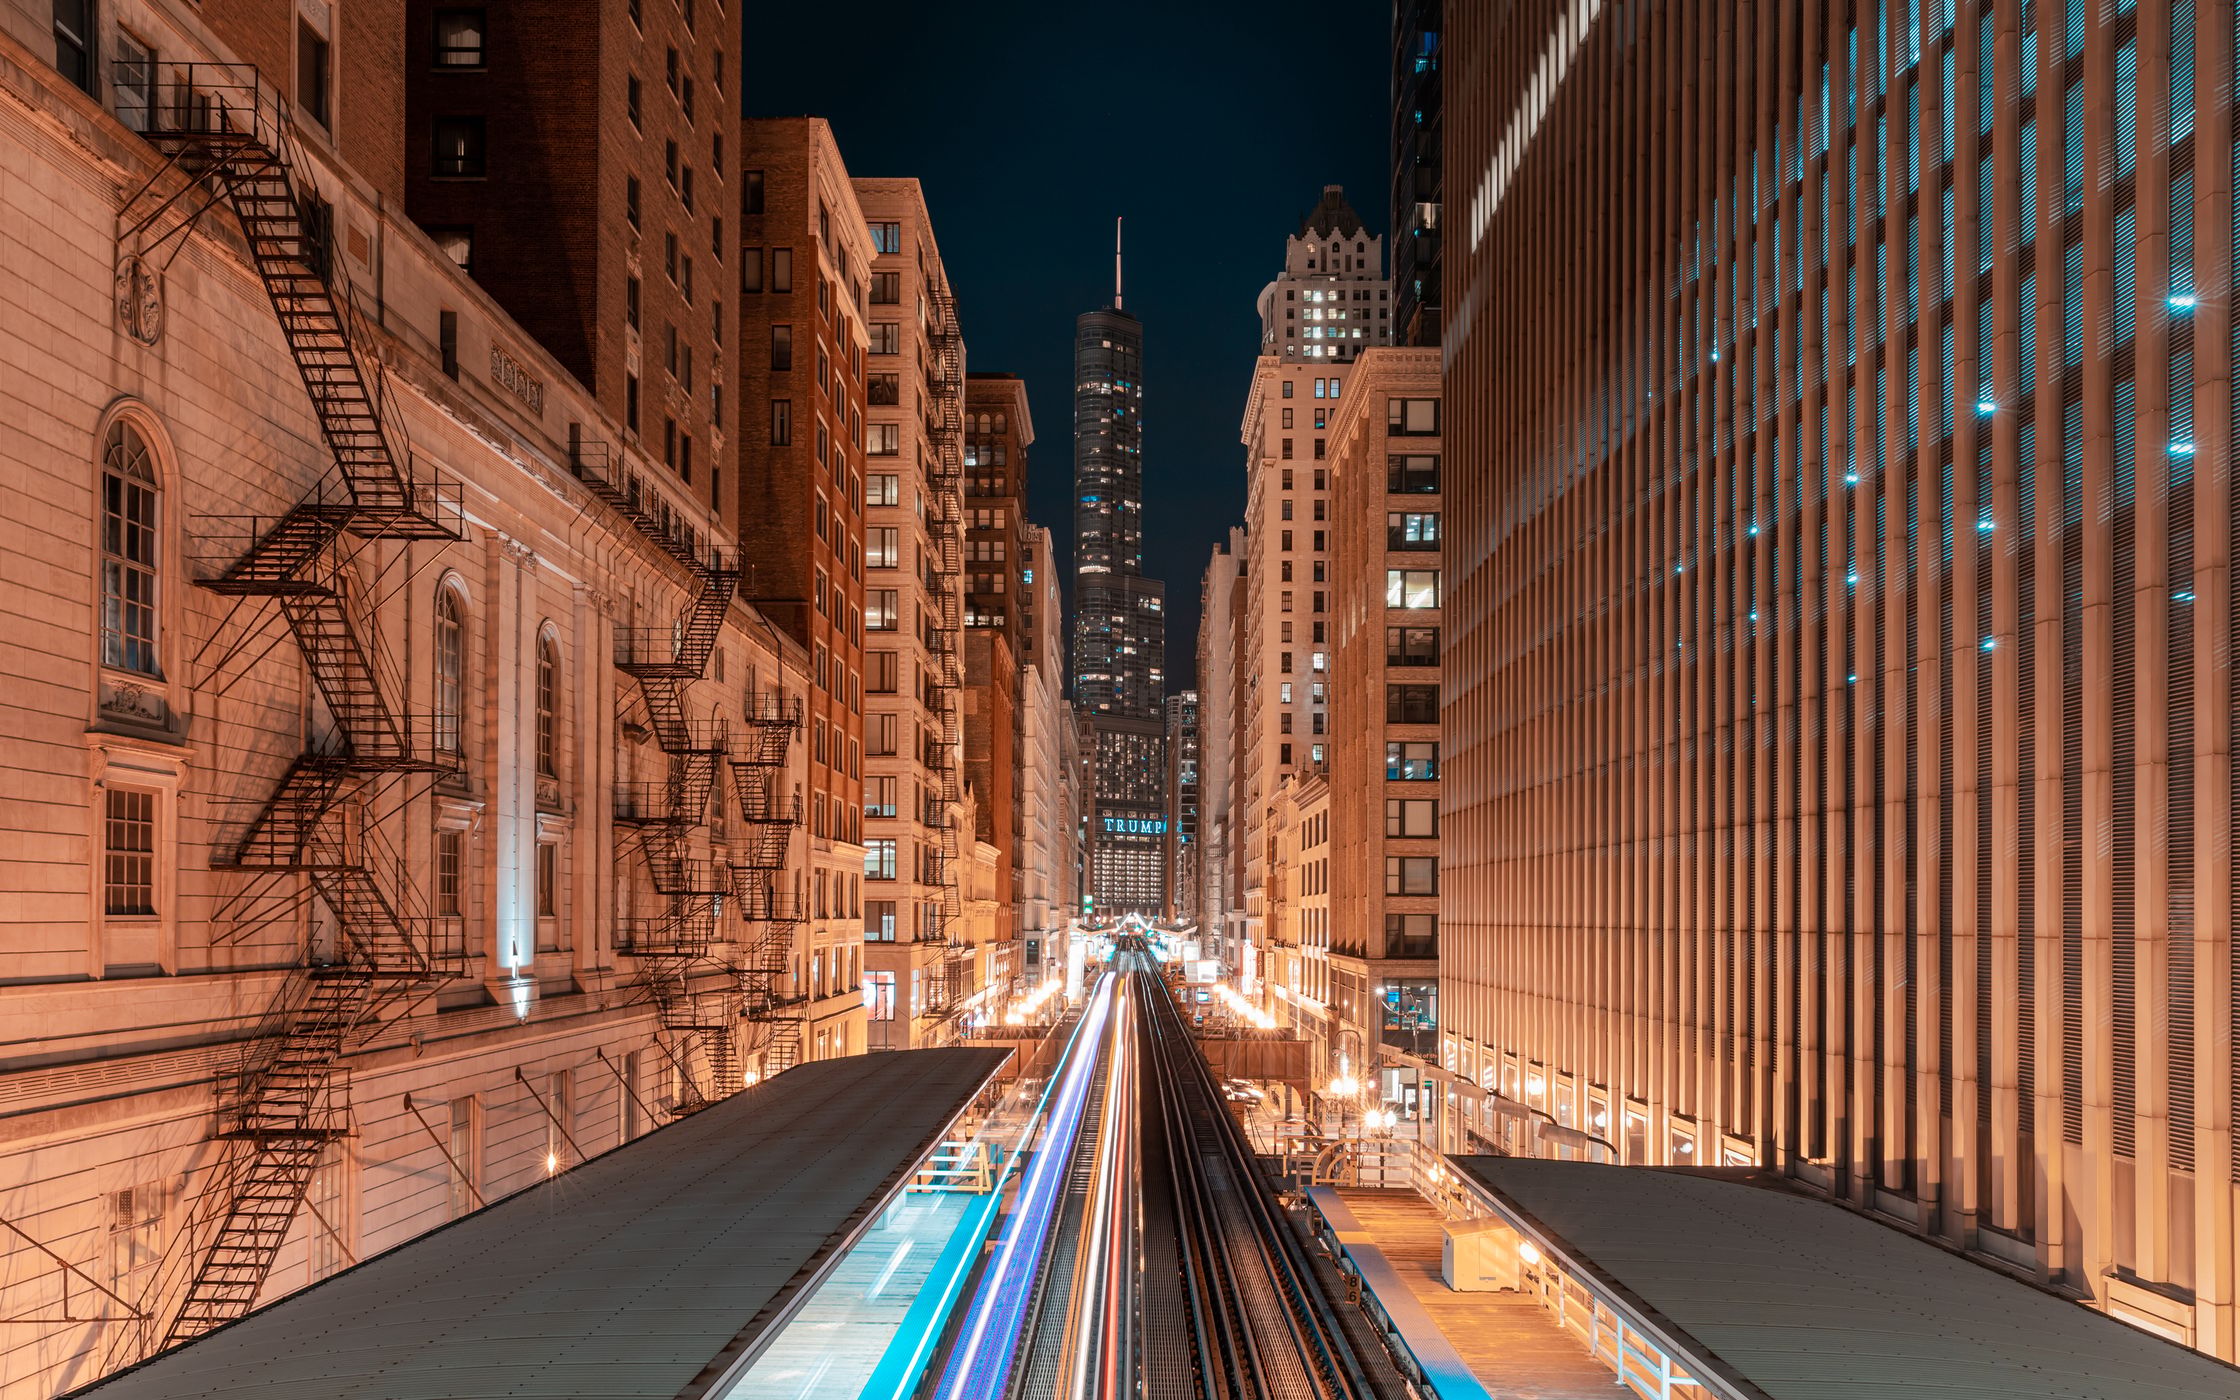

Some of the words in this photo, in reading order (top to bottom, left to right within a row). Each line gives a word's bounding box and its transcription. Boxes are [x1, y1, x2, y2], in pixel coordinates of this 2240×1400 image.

[1104, 818, 1162, 834] TRUMP
[1350, 1277, 1357, 1287] 8
[1350, 1291, 1357, 1301] 6
